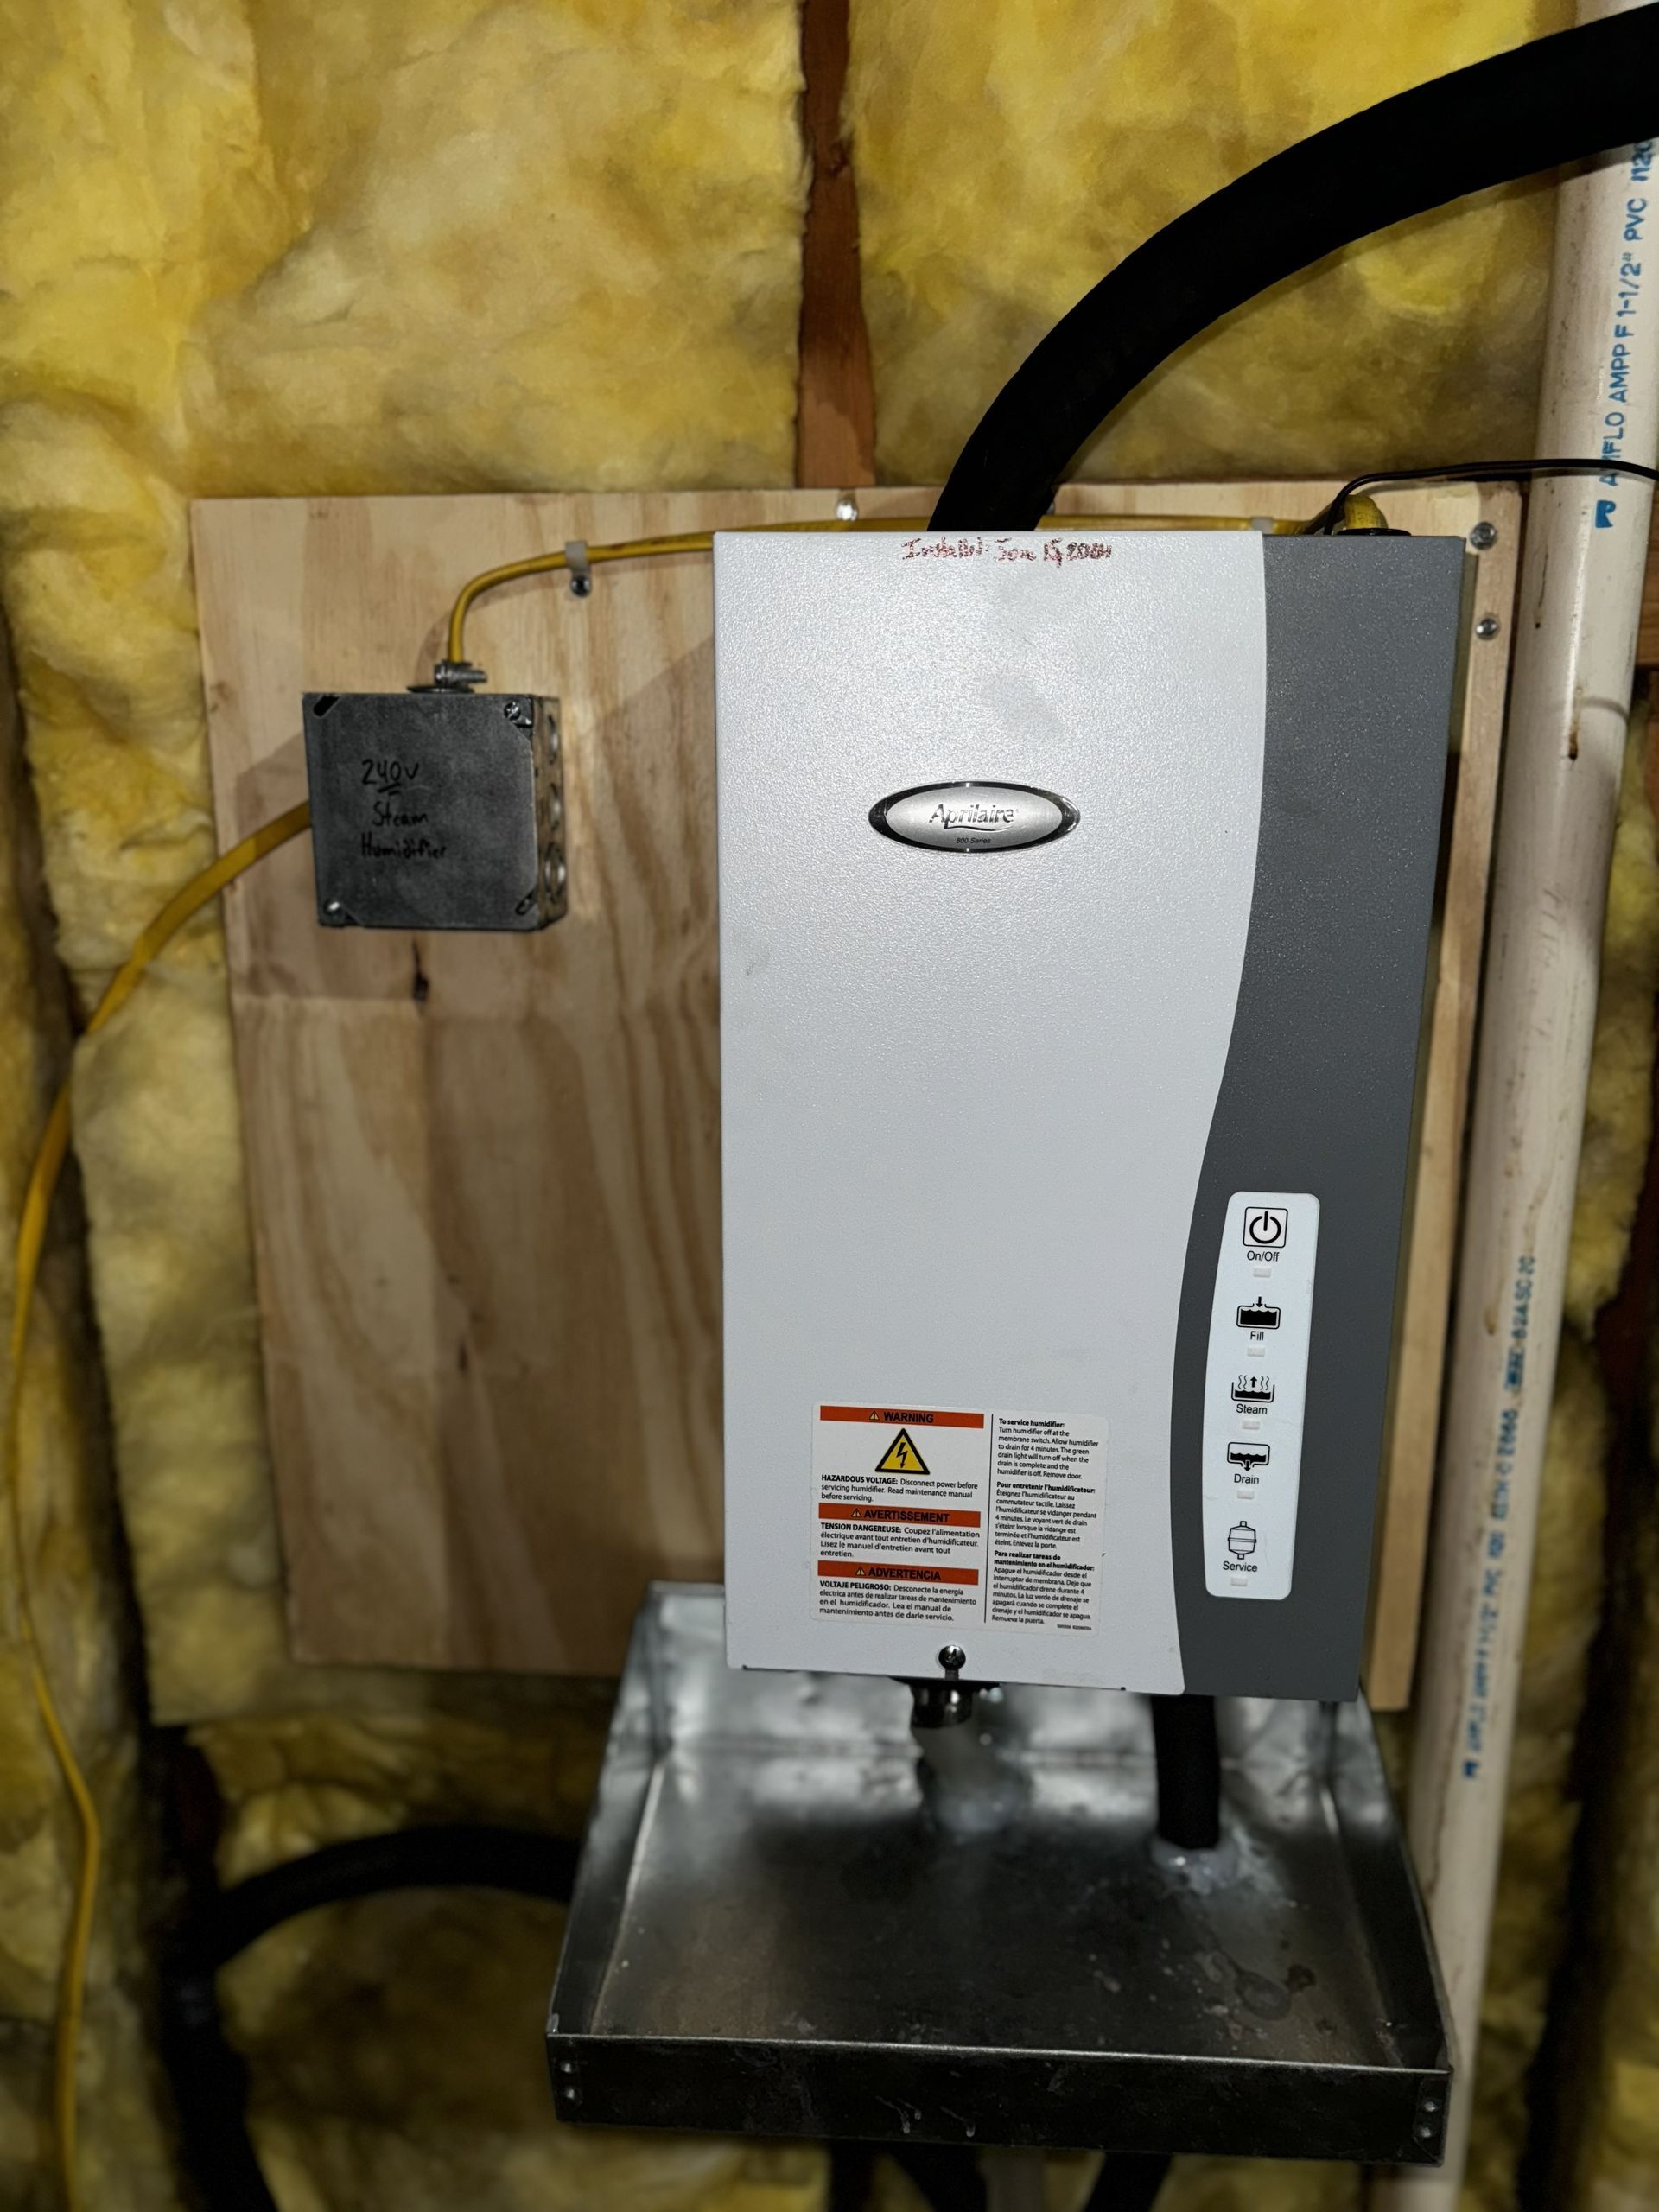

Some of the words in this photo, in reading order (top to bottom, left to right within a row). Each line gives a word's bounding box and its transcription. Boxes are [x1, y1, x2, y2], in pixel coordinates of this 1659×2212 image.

[1624, 198, 1647, 241] PVC
[1614, 325, 1633, 338] F
[1609, 344, 1630, 403] AMPP
[1599, 412, 1625, 486] AFLO
[372, 801, 429, 827] Steam
[929, 804, 1015, 830] Aprilaire
[362, 832, 446, 859] Humidifier
[1247, 1250, 1280, 1262] On/Off
[1250, 1331, 1264, 1341] Fill
[1236, 1403, 1268, 1414] Steam
[883, 1411, 934, 1423] WARNING
[821, 1474, 865, 1483] HAZARDOUS
[1234, 1473, 1259, 1484] Drain
[821, 1484, 850, 1492] servicing
[905, 1488, 947, 1497] maintenance
[995, 1490, 1021, 1498] Éteignez
[864, 1510, 950, 1523] AVERTISSEMENT
[1046, 1510, 1072, 1518] vidanger
[903, 1527, 931, 1535] Coupez
[1015, 1524, 1037, 1533] lorsque
[1043, 1526, 1066, 1535] vidange
[820, 1532, 854, 1541] électrique
[993, 1559, 1038, 1567] mantenimiento
[1223, 1560, 1258, 1572] Service
[868, 1567, 941, 1580] ADVERTENCIA
[893, 1585, 931, 1593] Desconecte
[927, 1596, 976, 1605] mantenimiento
[819, 1606, 874, 1616] mantenimiento
